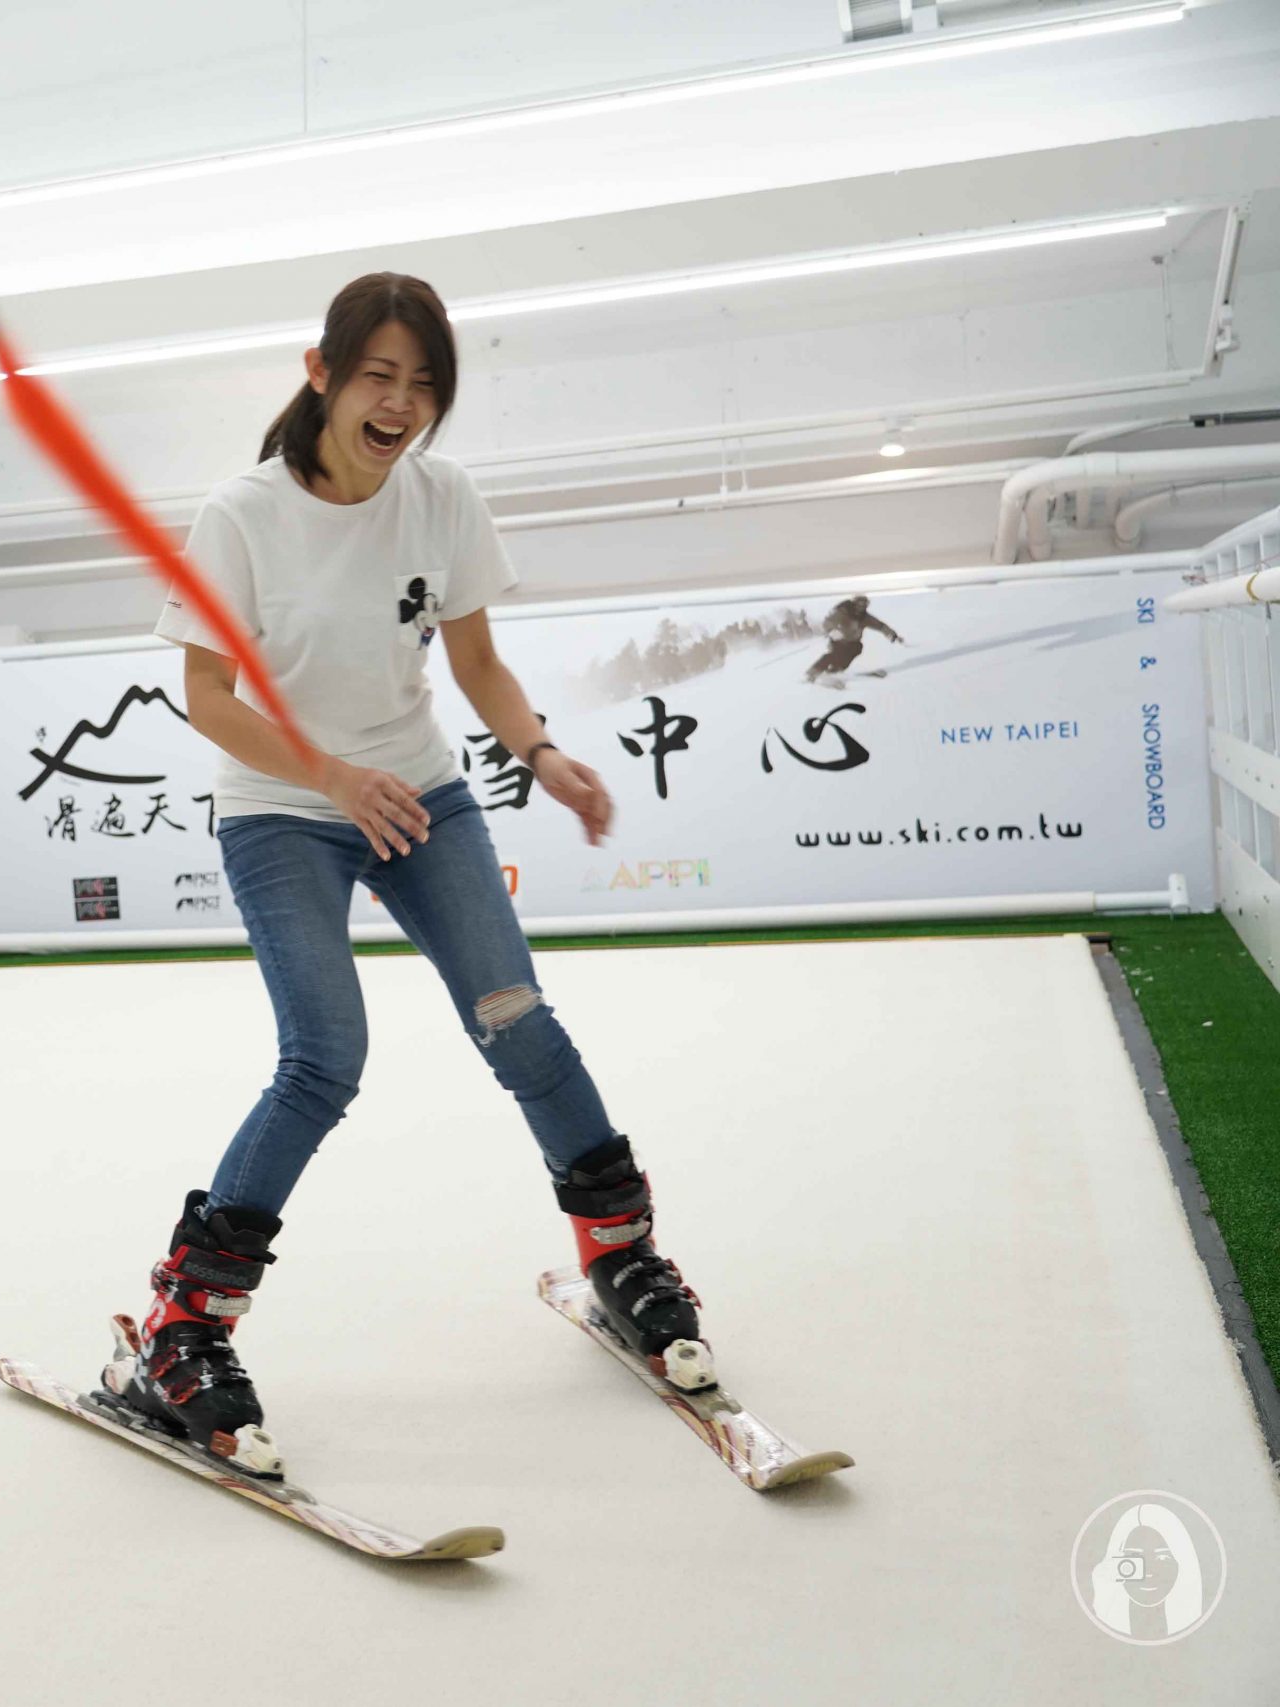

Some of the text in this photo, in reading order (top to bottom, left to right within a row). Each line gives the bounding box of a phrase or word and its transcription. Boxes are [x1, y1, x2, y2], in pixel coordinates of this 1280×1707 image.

[1136, 597, 1166, 830] SKI & SNOWBOARD
[941, 721, 1079, 745] NEW TAIPEI
[795, 812, 1083, 847] www.ski.com.tw
